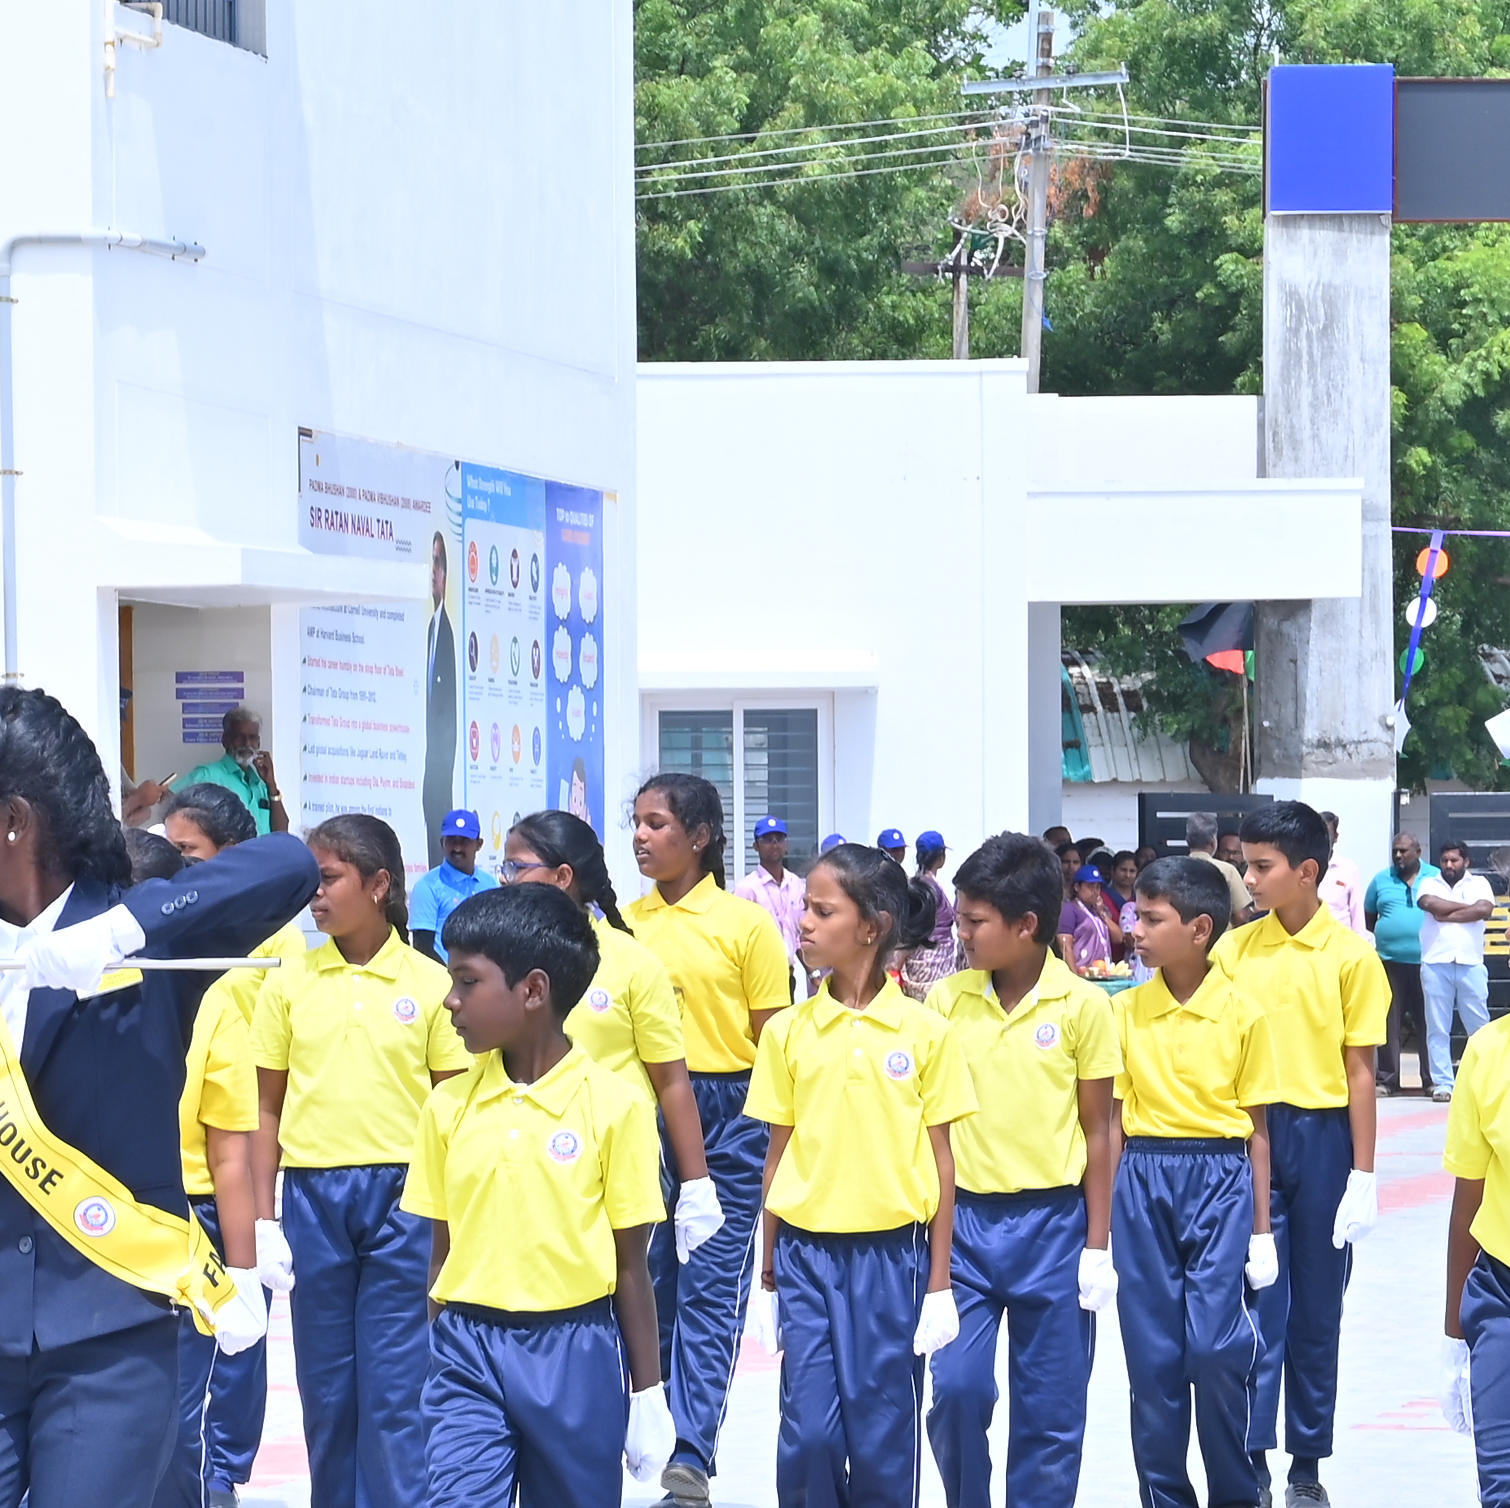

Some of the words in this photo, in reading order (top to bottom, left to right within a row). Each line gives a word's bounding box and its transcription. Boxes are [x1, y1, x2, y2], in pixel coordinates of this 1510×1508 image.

[309, 479, 323, 492] PADMA
[324, 482, 344, 496] BHUSHAN
[362, 489, 376, 502] PADMA
[412, 499, 431, 513] AWARDEE
[310, 506, 322, 529] SIR
[325, 509, 348, 533] RATAN
[351, 513, 374, 537] NAVAL
[376, 518, 394, 541] TATA
